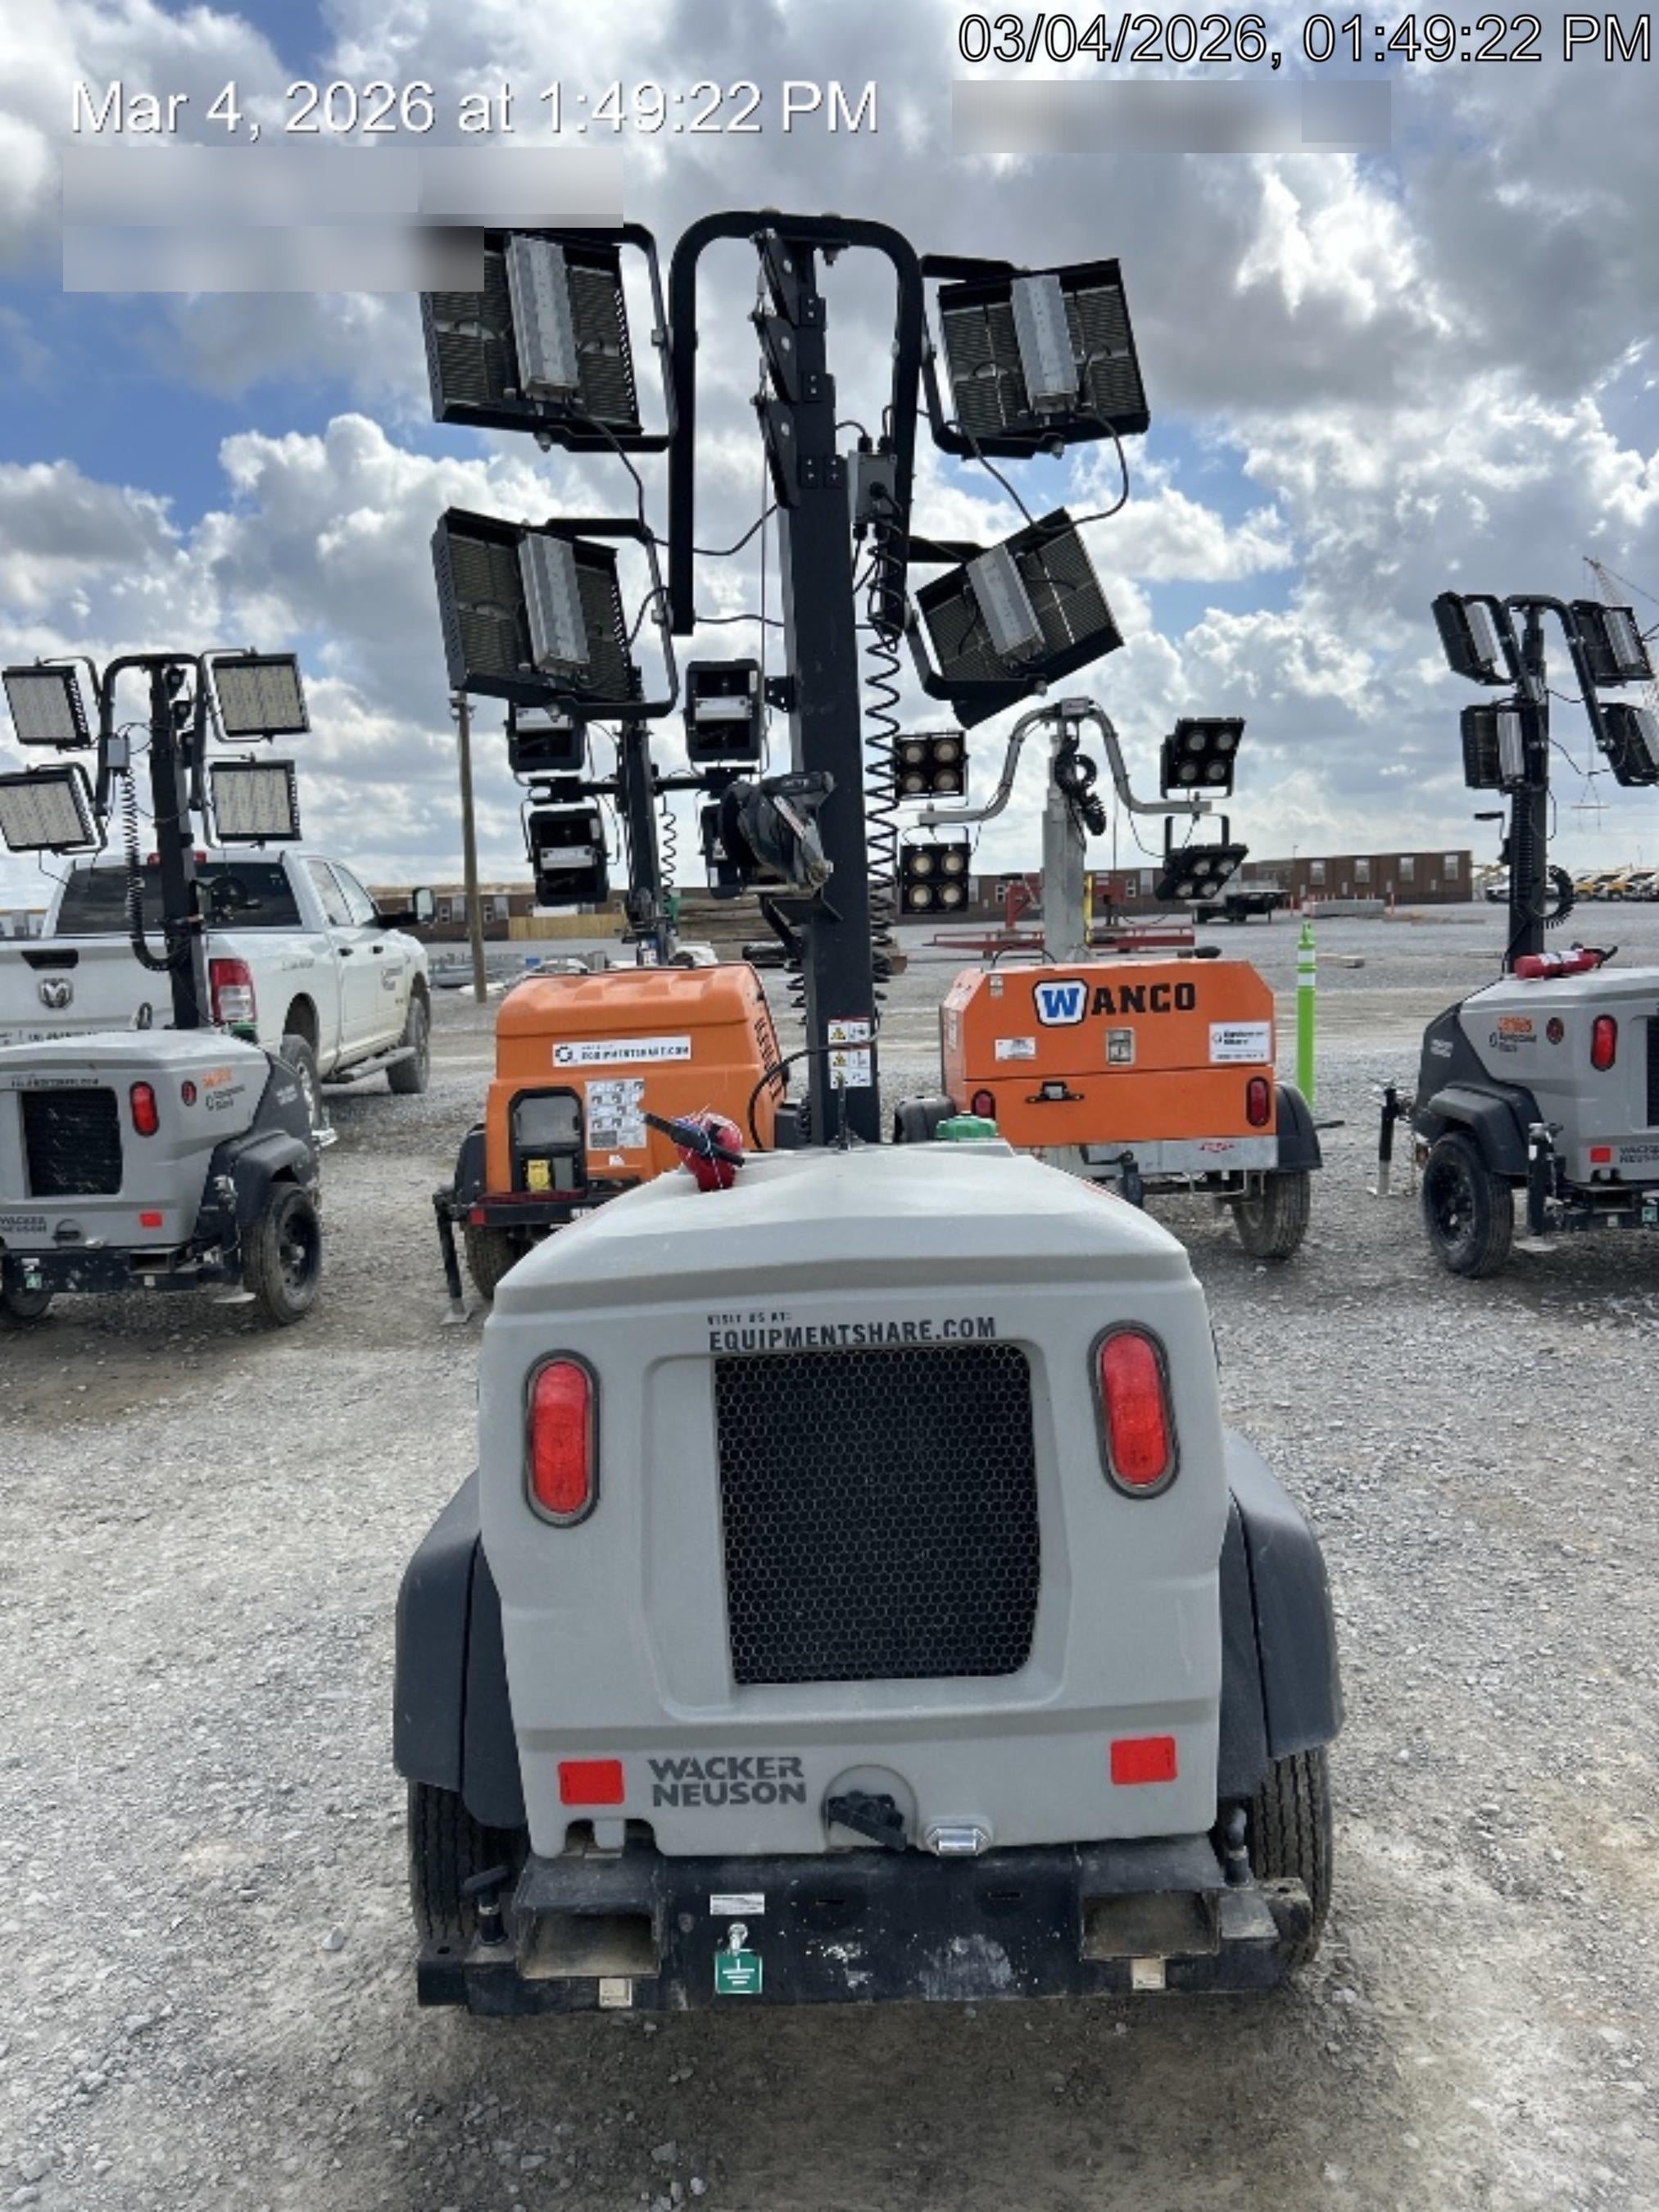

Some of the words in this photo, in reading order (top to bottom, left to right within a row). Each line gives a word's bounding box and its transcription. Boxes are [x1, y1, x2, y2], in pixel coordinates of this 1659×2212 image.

[1039, 981, 1196, 1020] WANCO
[749, 1312, 765, 1324] US
[709, 1317, 996, 1351] EQUIPMENTSHARE.COM
[647, 1756, 805, 1782] WACKER
[653, 1781, 807, 1808] NEUSON
